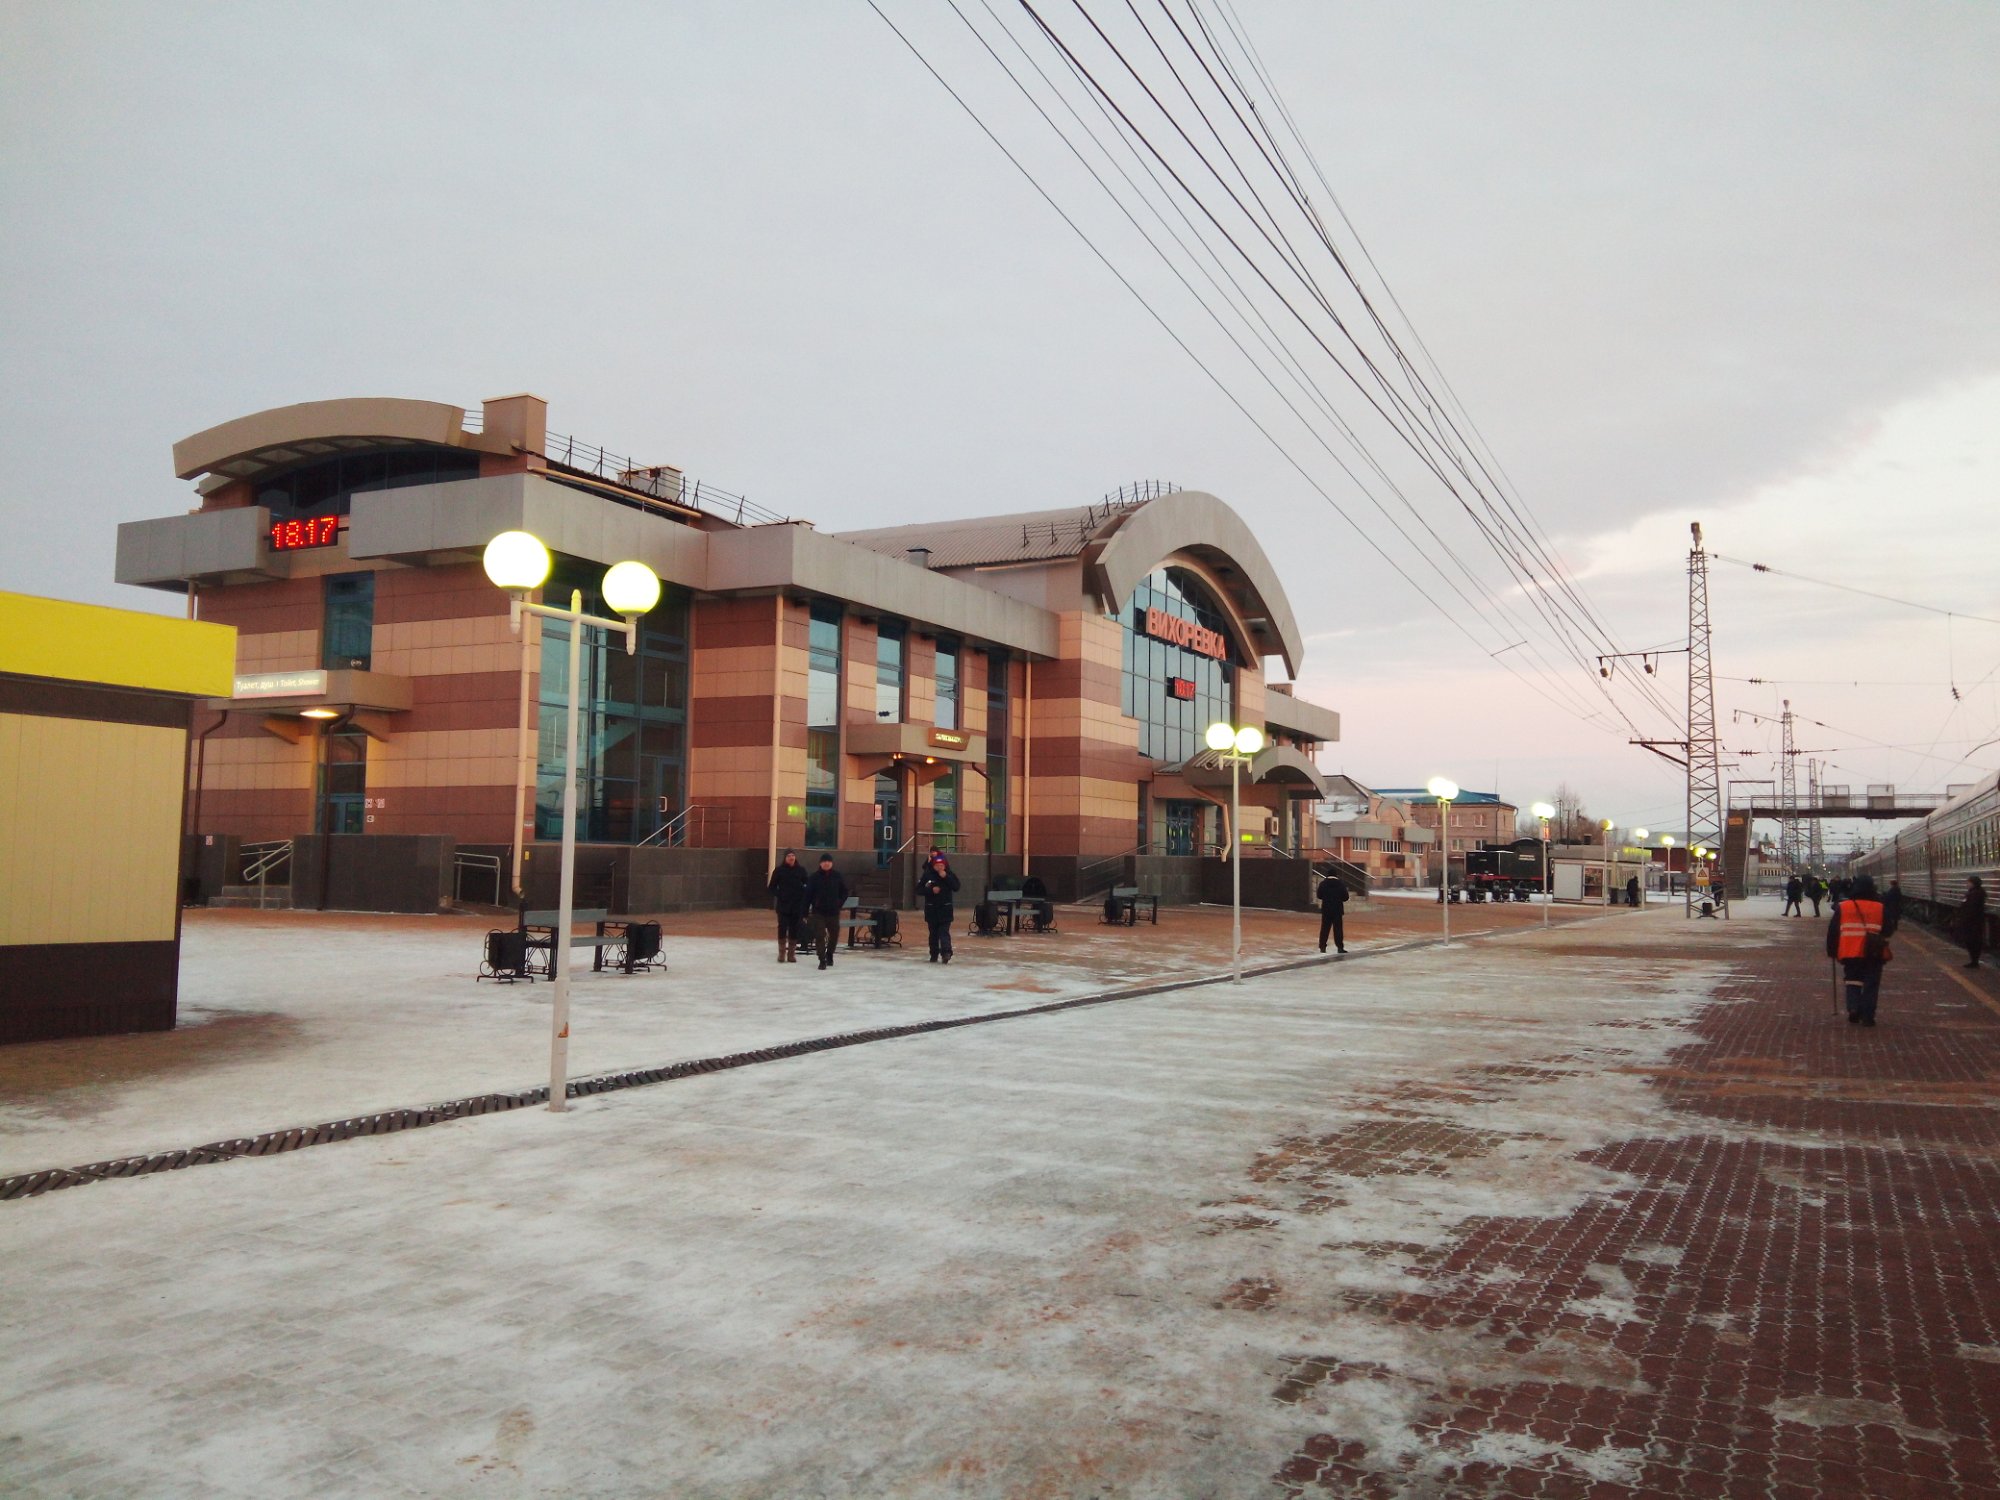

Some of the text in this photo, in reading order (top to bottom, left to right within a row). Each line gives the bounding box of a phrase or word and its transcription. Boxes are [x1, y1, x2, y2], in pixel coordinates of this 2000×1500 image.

[1146, 606, 1226, 661] ВИХОРЕВКА
[236, 680, 260, 691] Туалет,
[260, 680, 274, 690] душ
